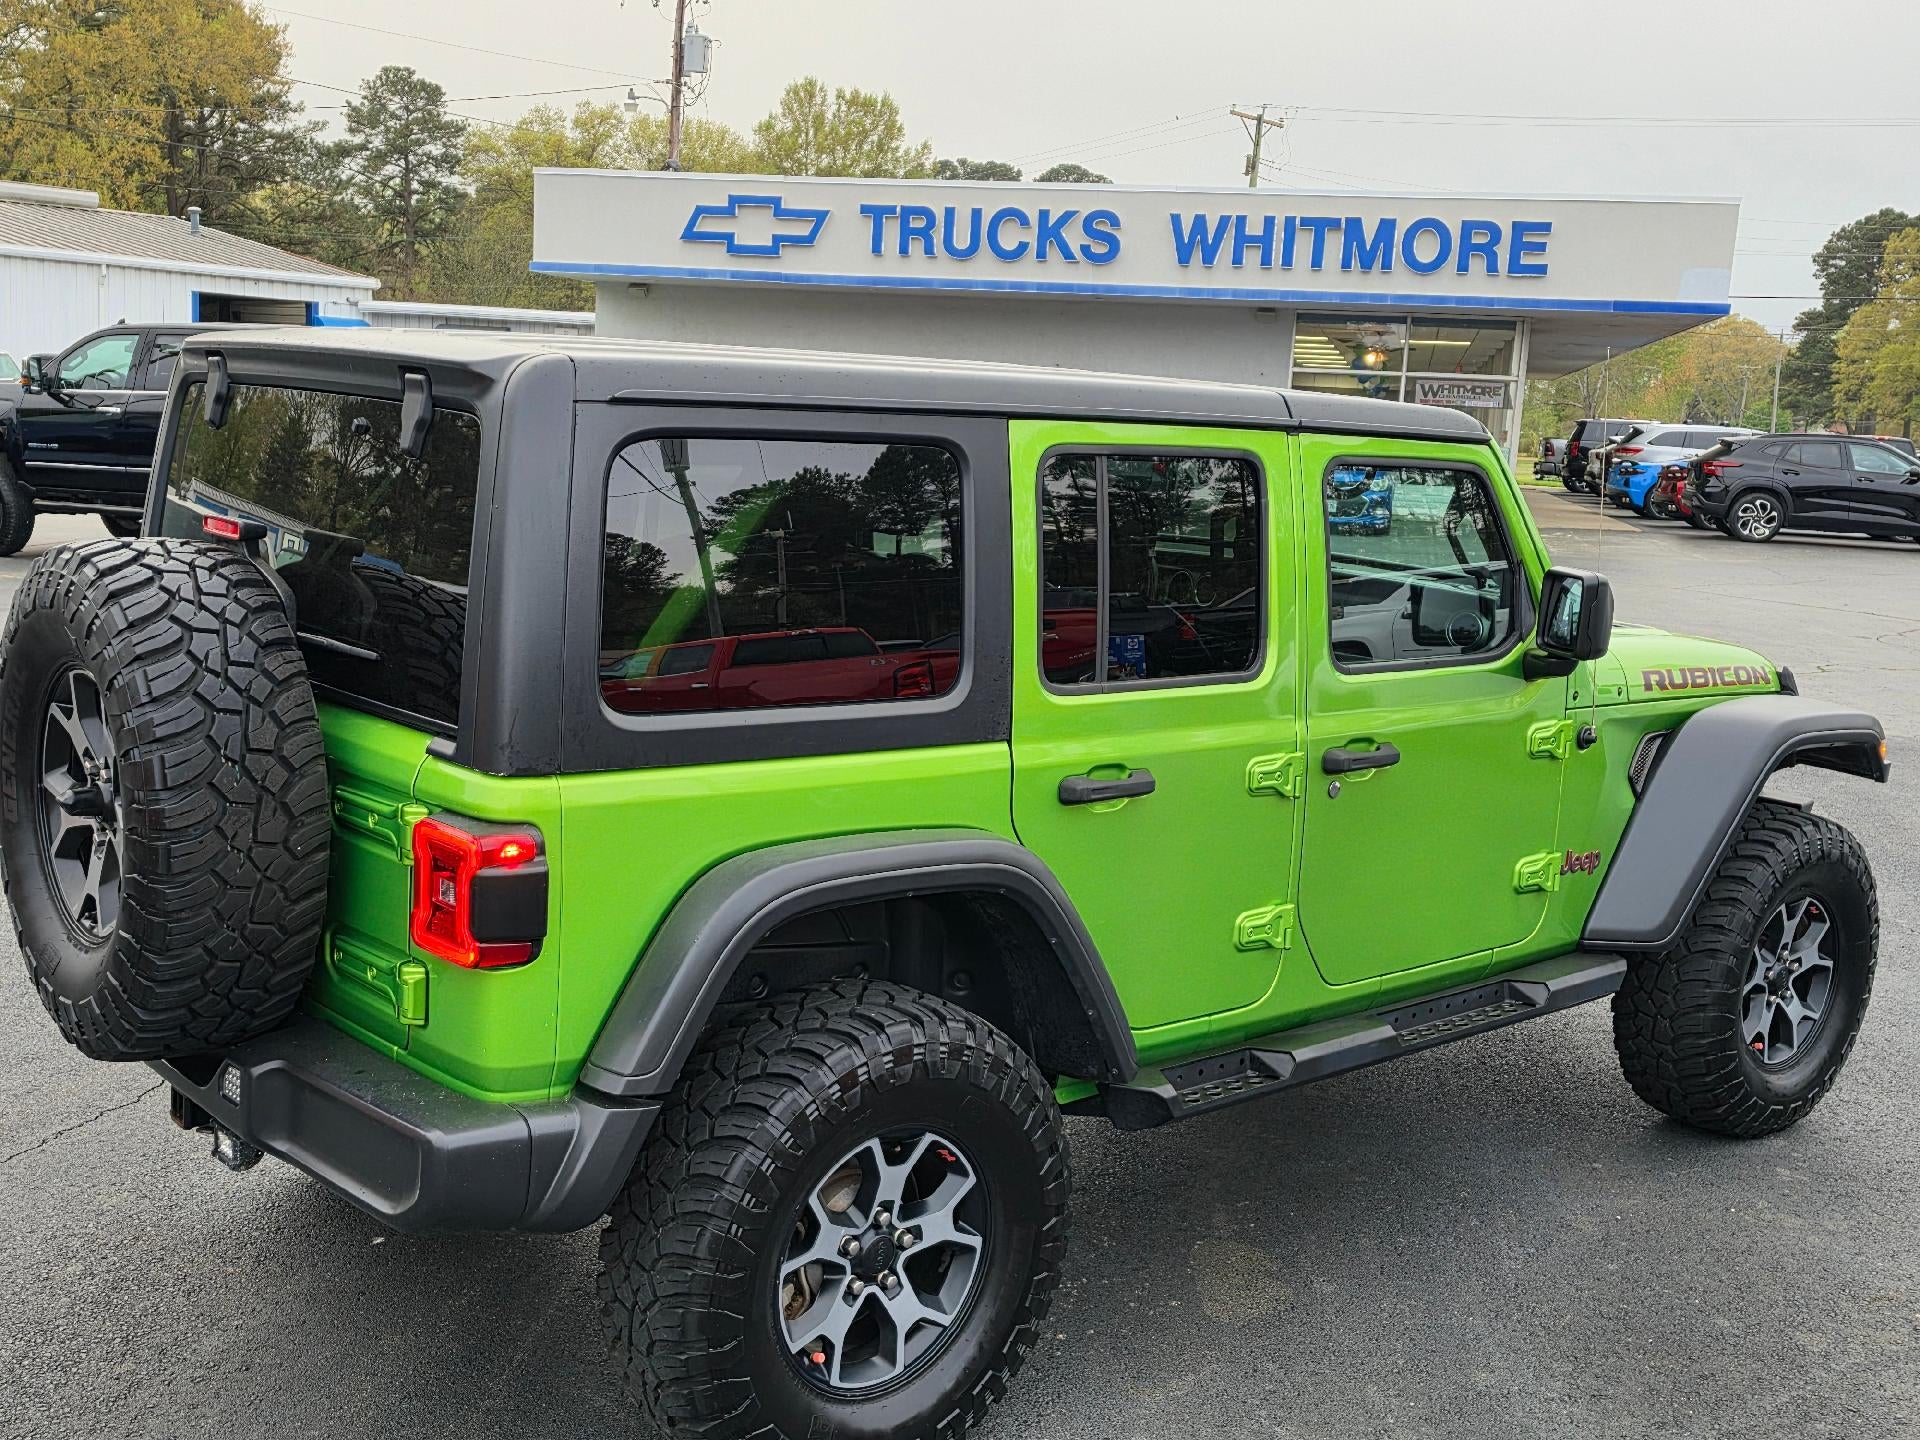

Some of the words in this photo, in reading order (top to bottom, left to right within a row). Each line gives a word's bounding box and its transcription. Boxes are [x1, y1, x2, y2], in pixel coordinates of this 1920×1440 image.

[860, 204, 1121, 265] TRUCKS
[1170, 213, 1553, 277] WHITMORE
[1419, 383, 1503, 398] WHITMORE
[1641, 666, 1771, 692] RUBICON
[1560, 849, 1601, 875] Jeep
